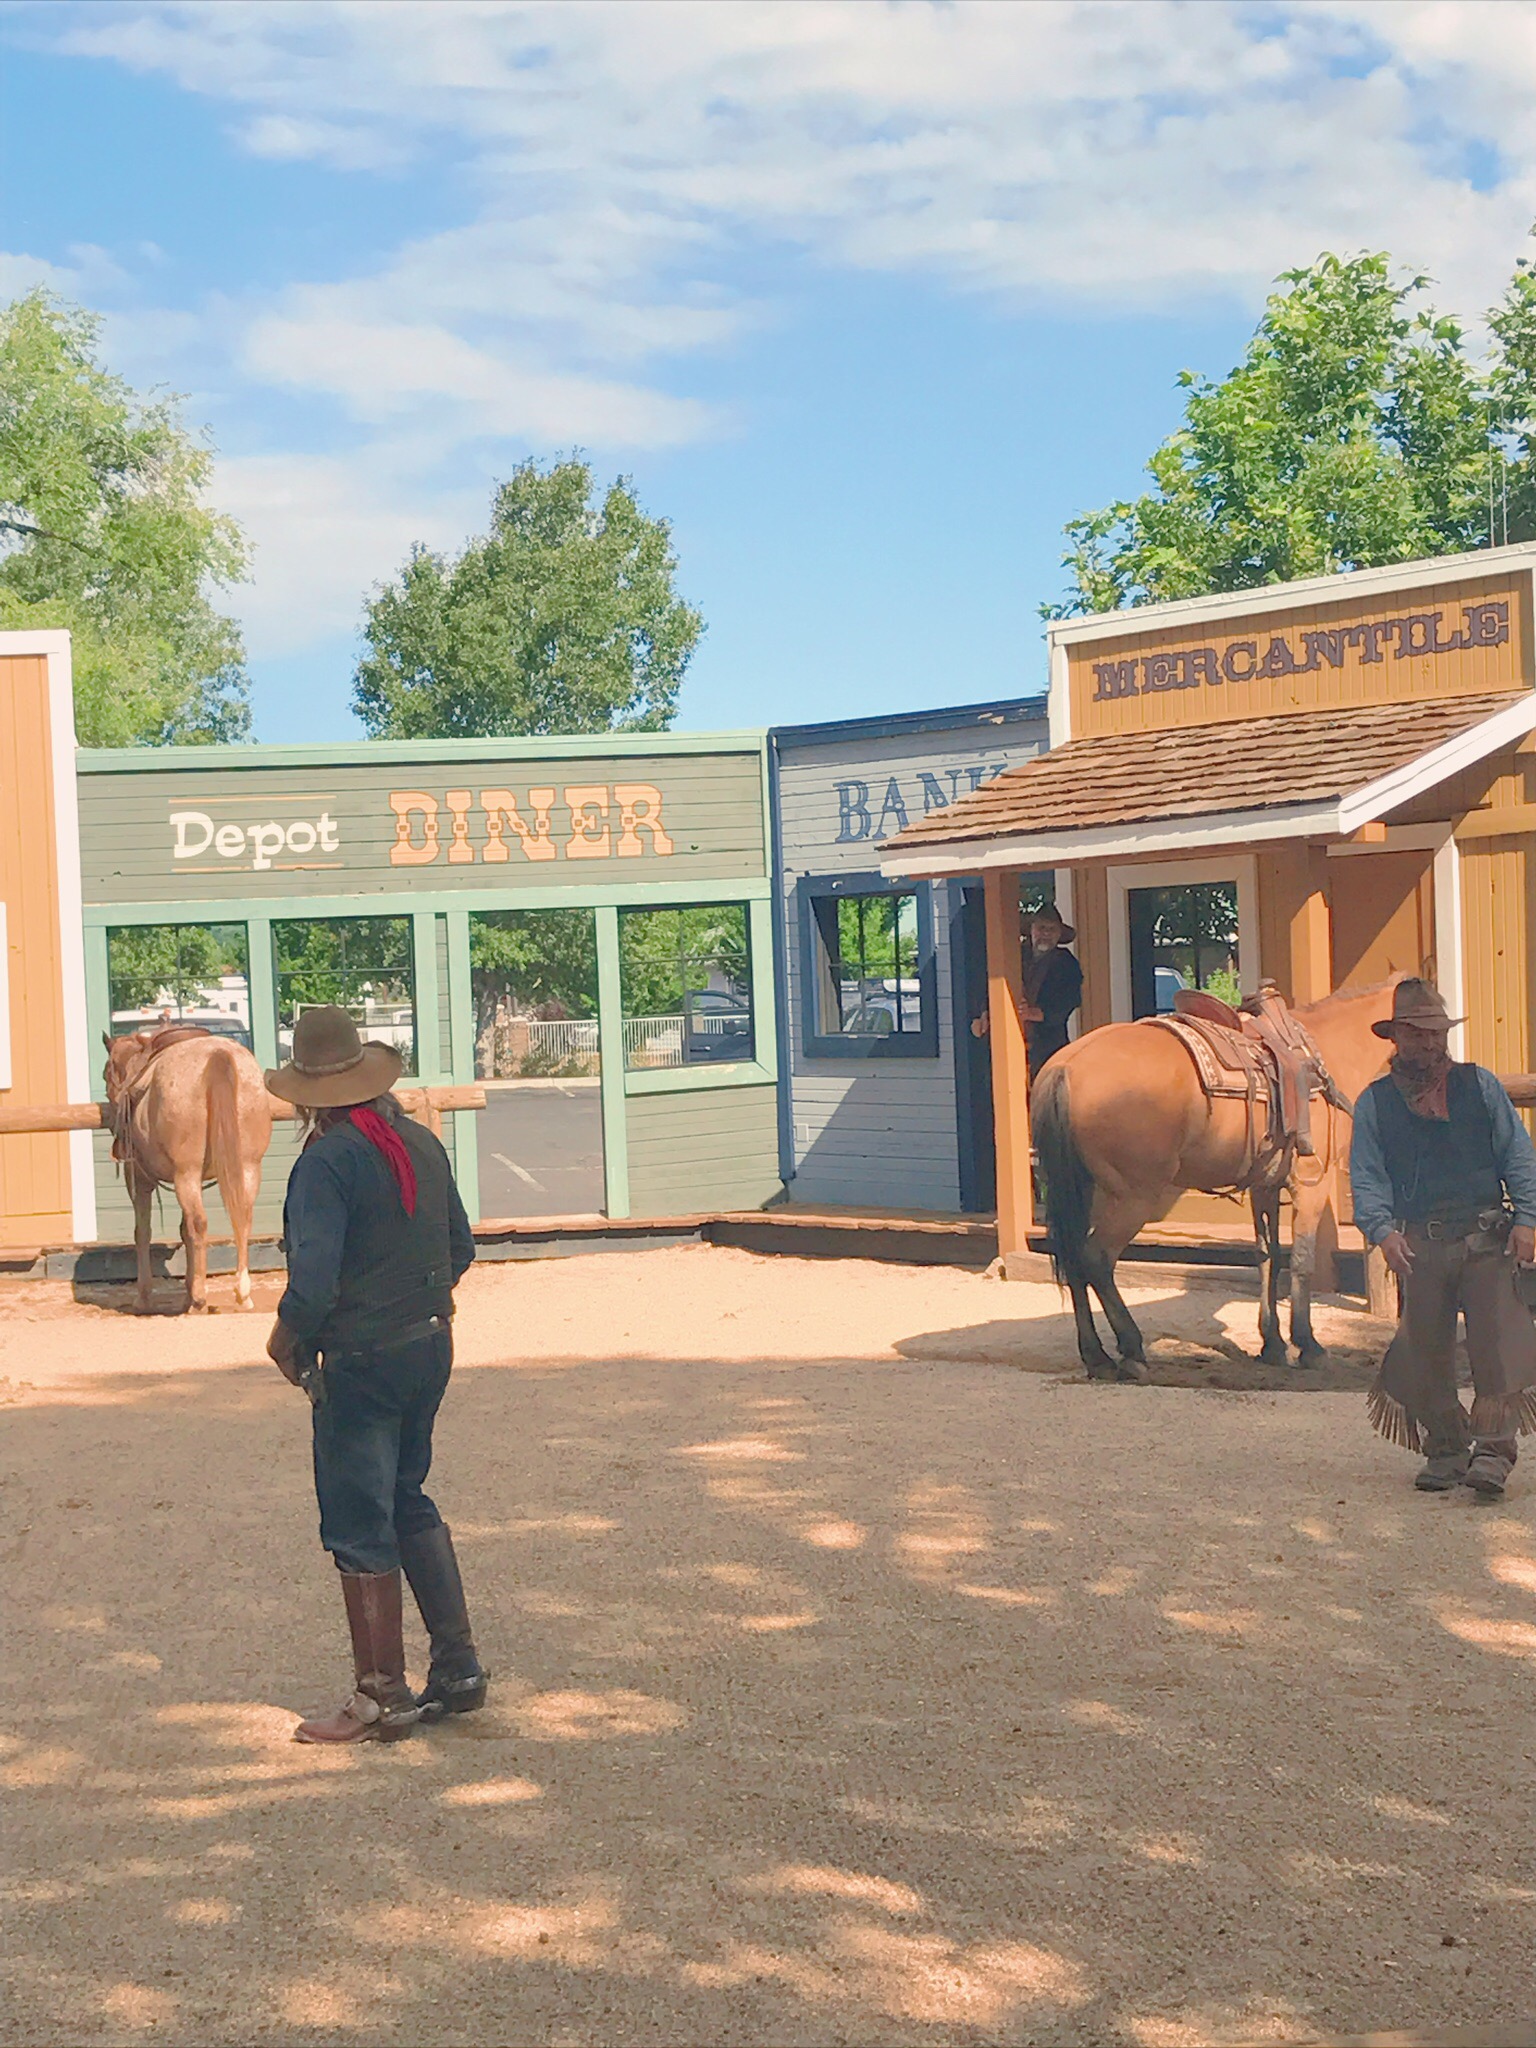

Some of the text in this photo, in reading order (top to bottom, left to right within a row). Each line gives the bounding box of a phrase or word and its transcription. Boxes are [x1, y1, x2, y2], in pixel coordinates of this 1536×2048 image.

[1092, 601, 1510, 702] MERCANTILE
[169, 783, 675, 870] Depot DINER
